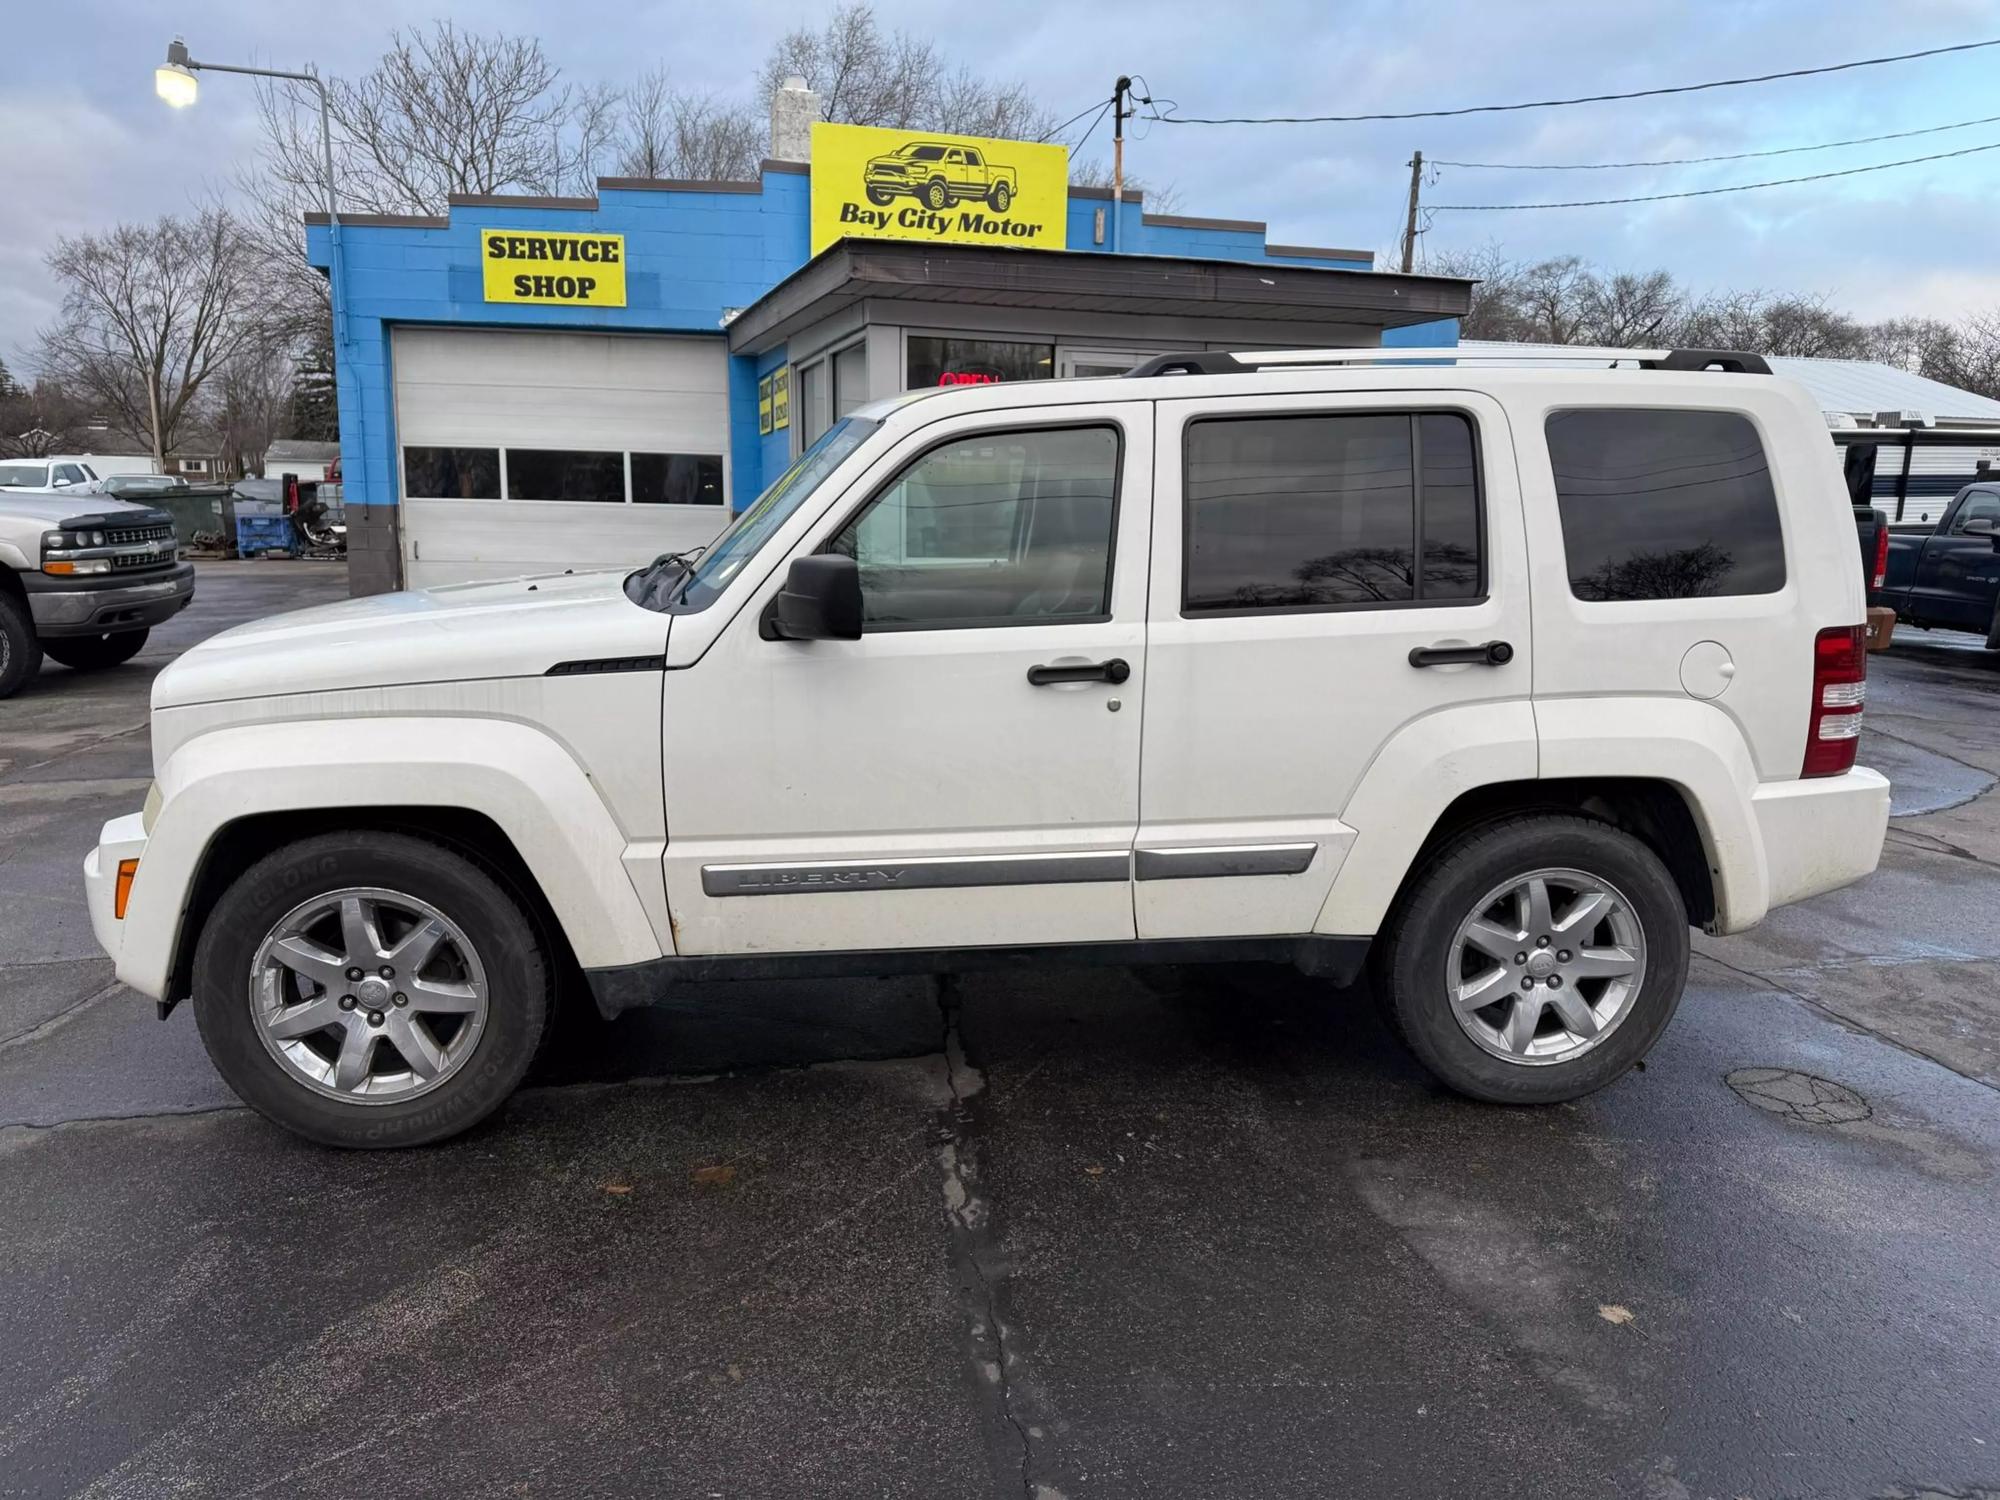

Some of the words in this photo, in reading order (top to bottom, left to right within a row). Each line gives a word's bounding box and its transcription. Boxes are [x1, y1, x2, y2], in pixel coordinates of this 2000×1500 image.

[840, 202, 893, 231] Bay
[898, 207, 953, 236] City
[957, 212, 1043, 238] Motor
[487, 236, 619, 263] SERVICE
[513, 274, 596, 299] SHOP
[738, 868, 906, 888] LIBERTY
